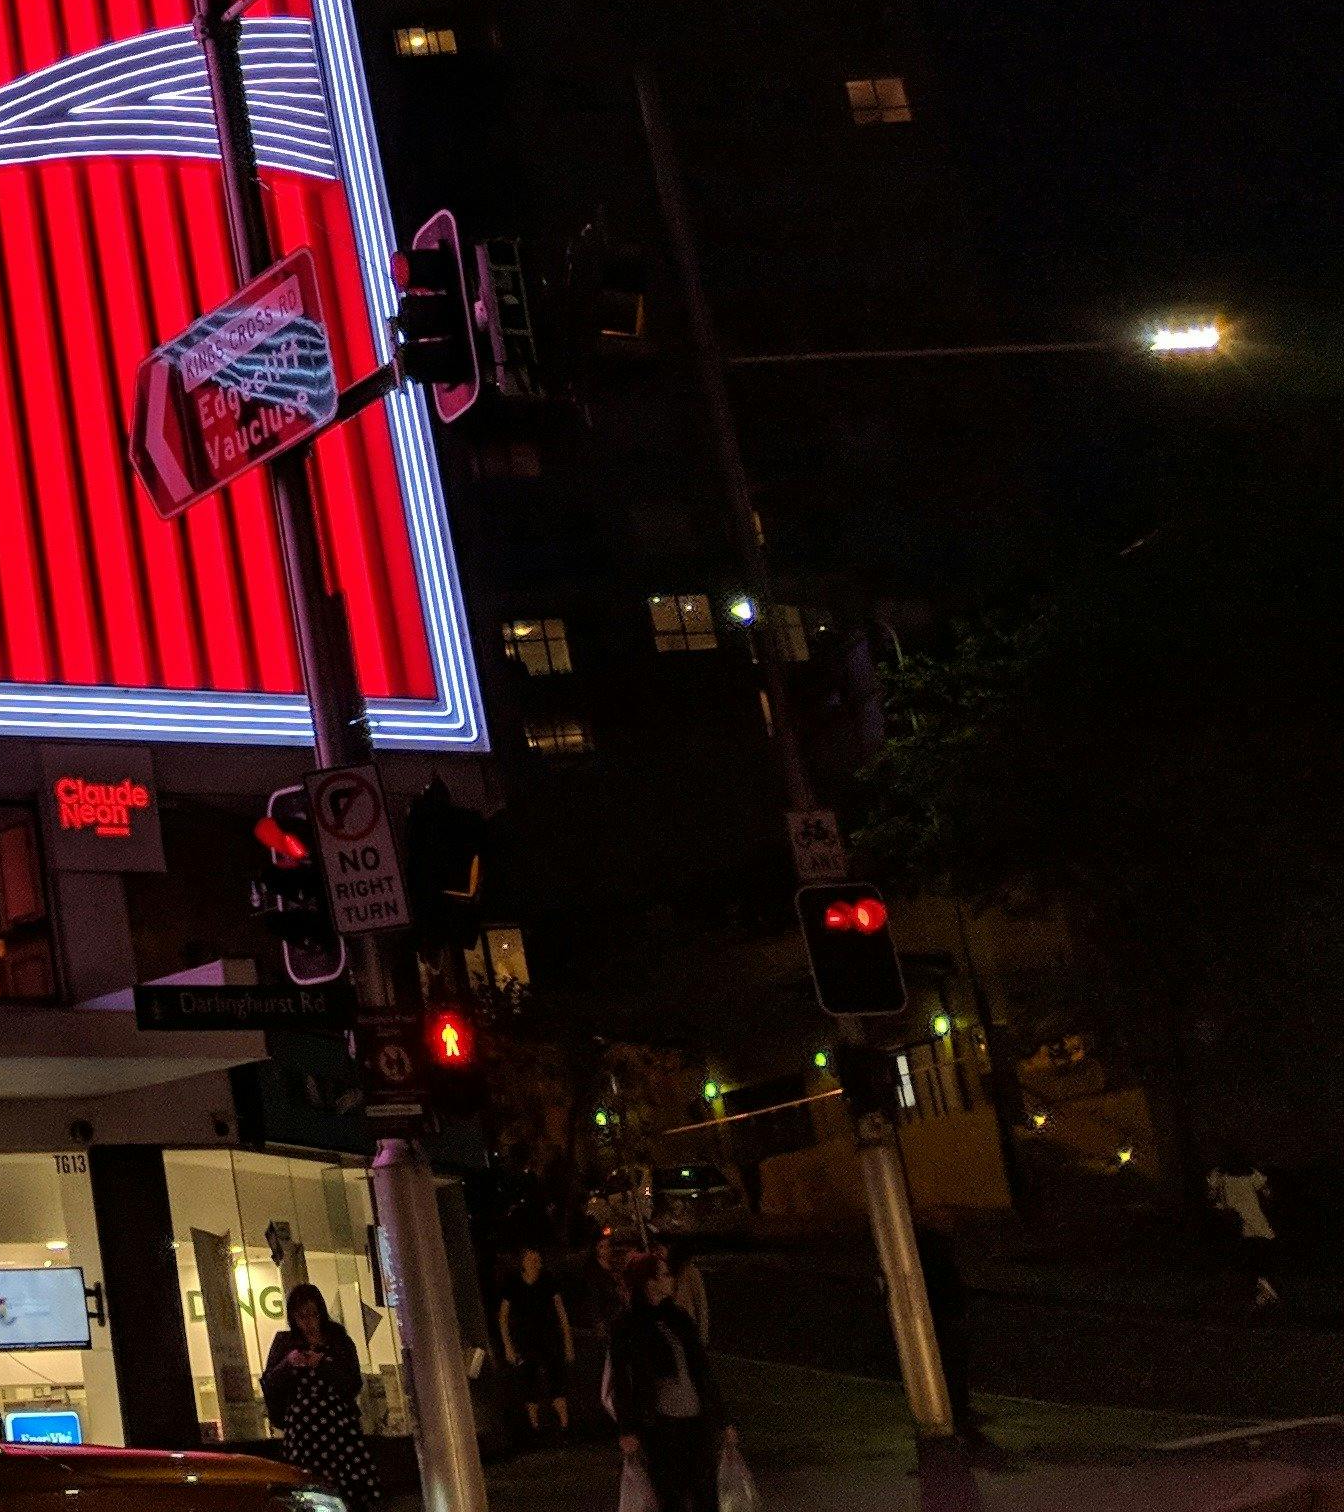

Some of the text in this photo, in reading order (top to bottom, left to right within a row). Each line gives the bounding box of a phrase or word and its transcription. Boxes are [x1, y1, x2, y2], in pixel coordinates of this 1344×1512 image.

[227, 306, 274, 349] CROSS
[279, 288, 298, 317] RD
[205, 390, 309, 470] Vaucluse
[56, 776, 149, 807] Claude
[60, 803, 129, 828] Neon
[338, 846, 381, 874] NO
[335, 875, 395, 900] RIGHT
[343, 899, 400, 923] TURN
[178, 990, 328, 1020] Darlinghurst Rd
